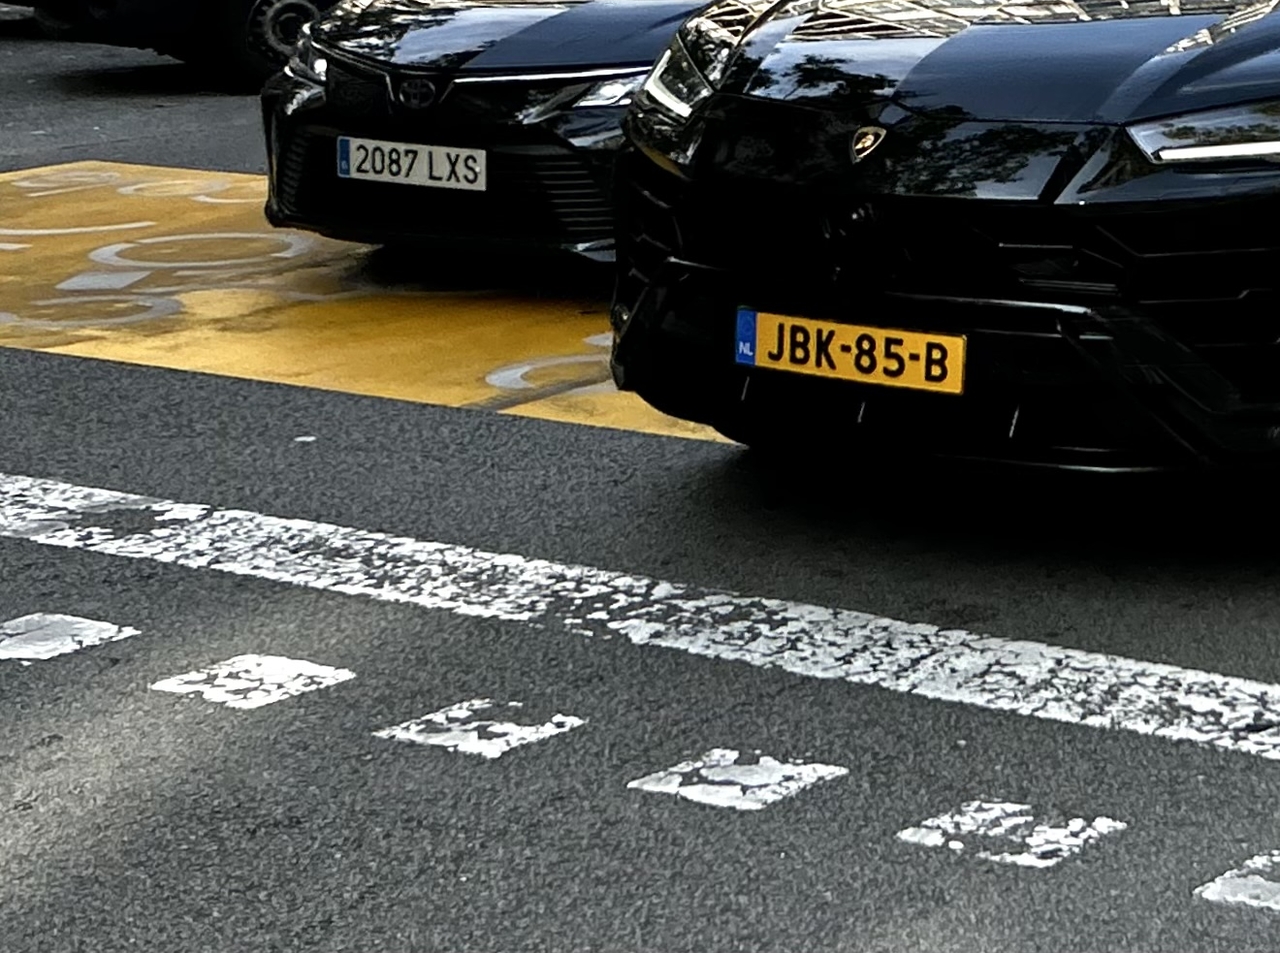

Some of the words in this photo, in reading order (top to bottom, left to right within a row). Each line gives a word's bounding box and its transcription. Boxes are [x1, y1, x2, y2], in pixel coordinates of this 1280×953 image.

[356, 144, 418, 178] 2087
[428, 151, 479, 184] LXS
[739, 341, 753, 356] NL
[767, 322, 949, 383] JBK-85-B
